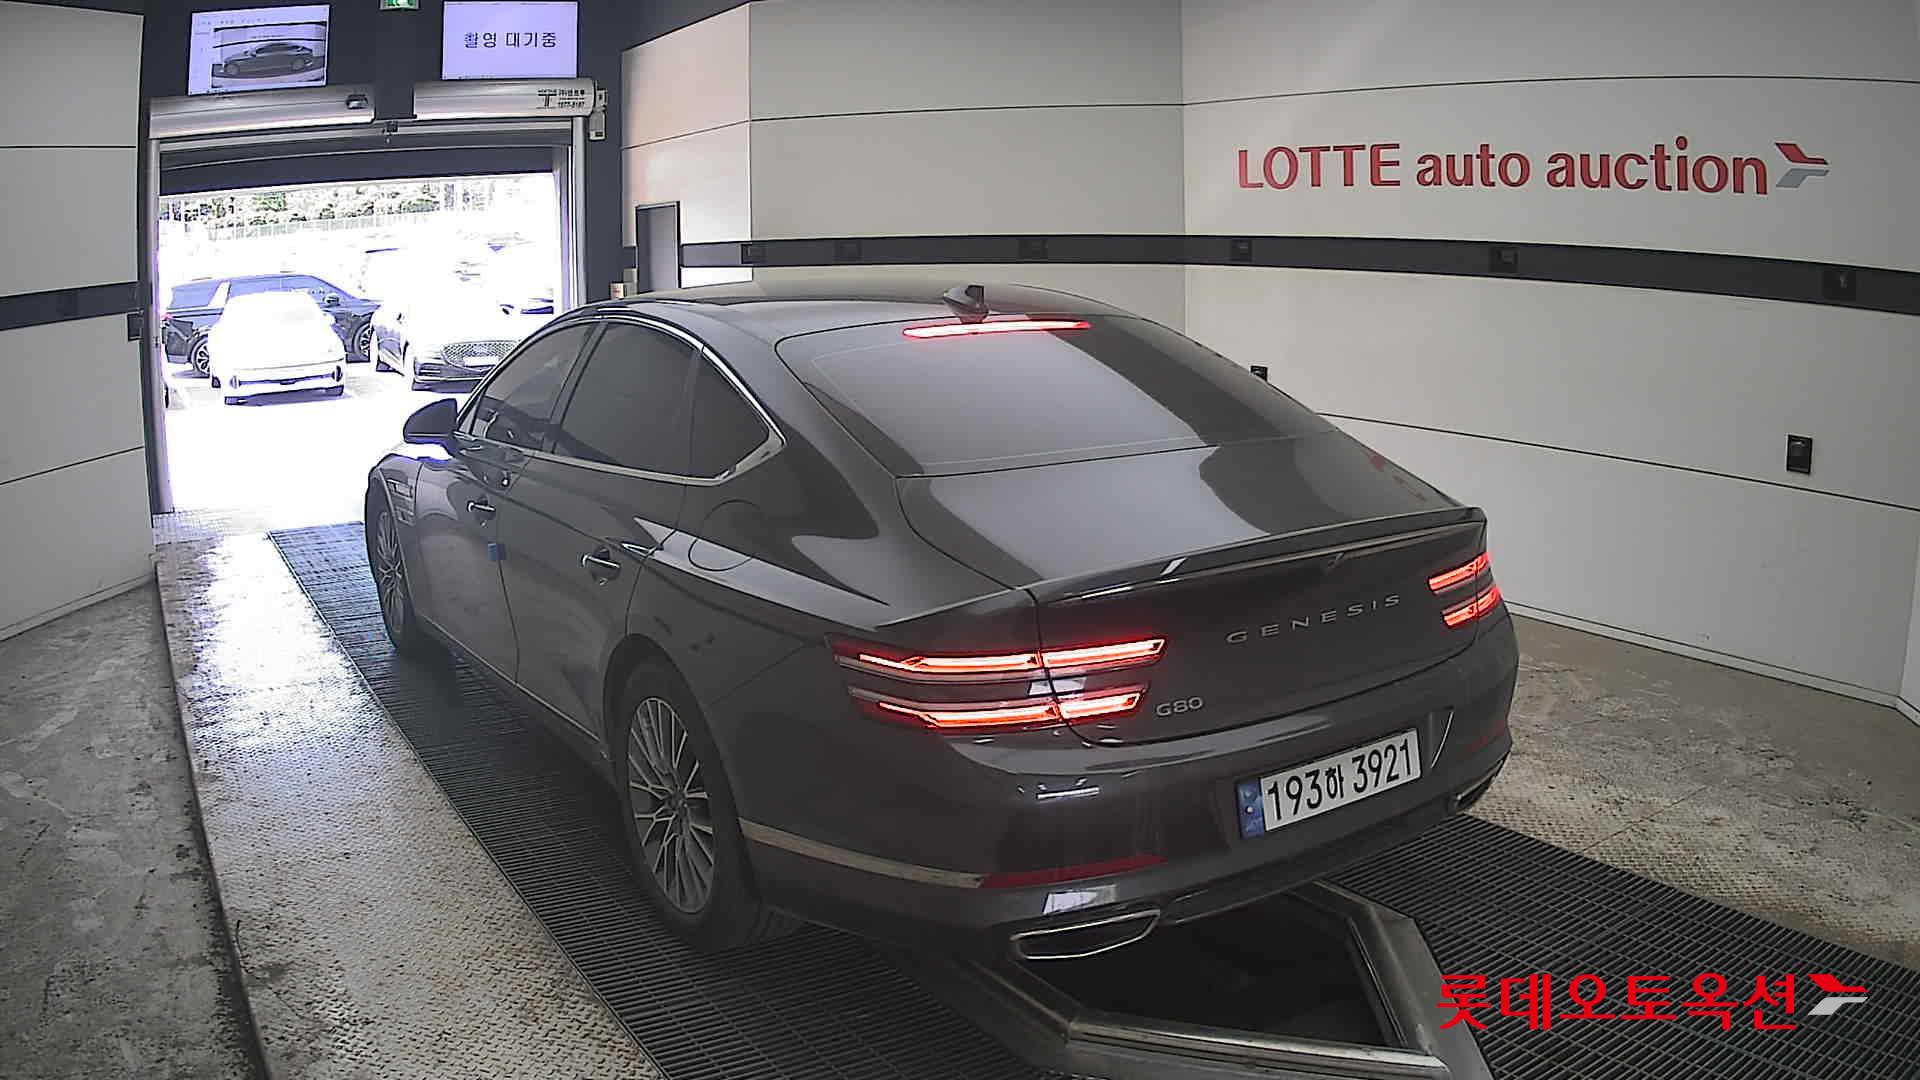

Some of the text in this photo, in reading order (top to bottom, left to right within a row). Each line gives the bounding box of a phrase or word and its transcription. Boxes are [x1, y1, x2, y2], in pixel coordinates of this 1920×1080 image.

[505, 32, 557, 48] 대기중
[1238, 136, 1768, 195] LOTTE auto auction
[1226, 594, 1400, 644] GENESIS
[1155, 697, 1204, 716] G80
[1267, 738, 1413, 821] 193하 3921
